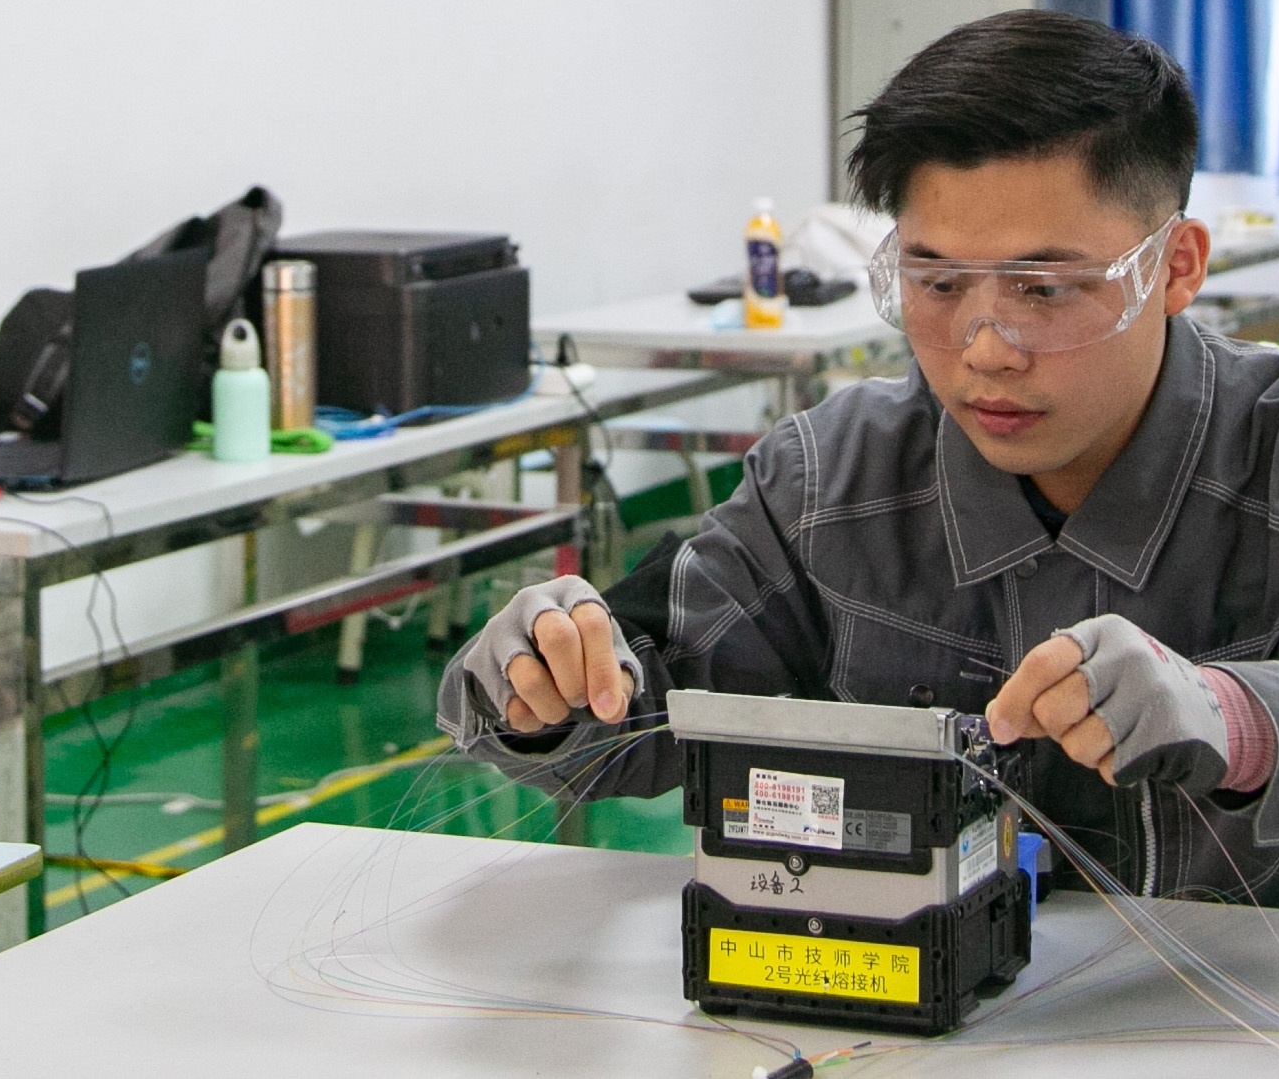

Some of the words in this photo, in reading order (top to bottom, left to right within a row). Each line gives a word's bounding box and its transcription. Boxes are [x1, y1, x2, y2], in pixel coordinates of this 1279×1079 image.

[845, 822, 863, 837] CE
[720, 938, 910, 974] 中山市技师学院
[764, 965, 888, 994] 2号光纤熔接机
